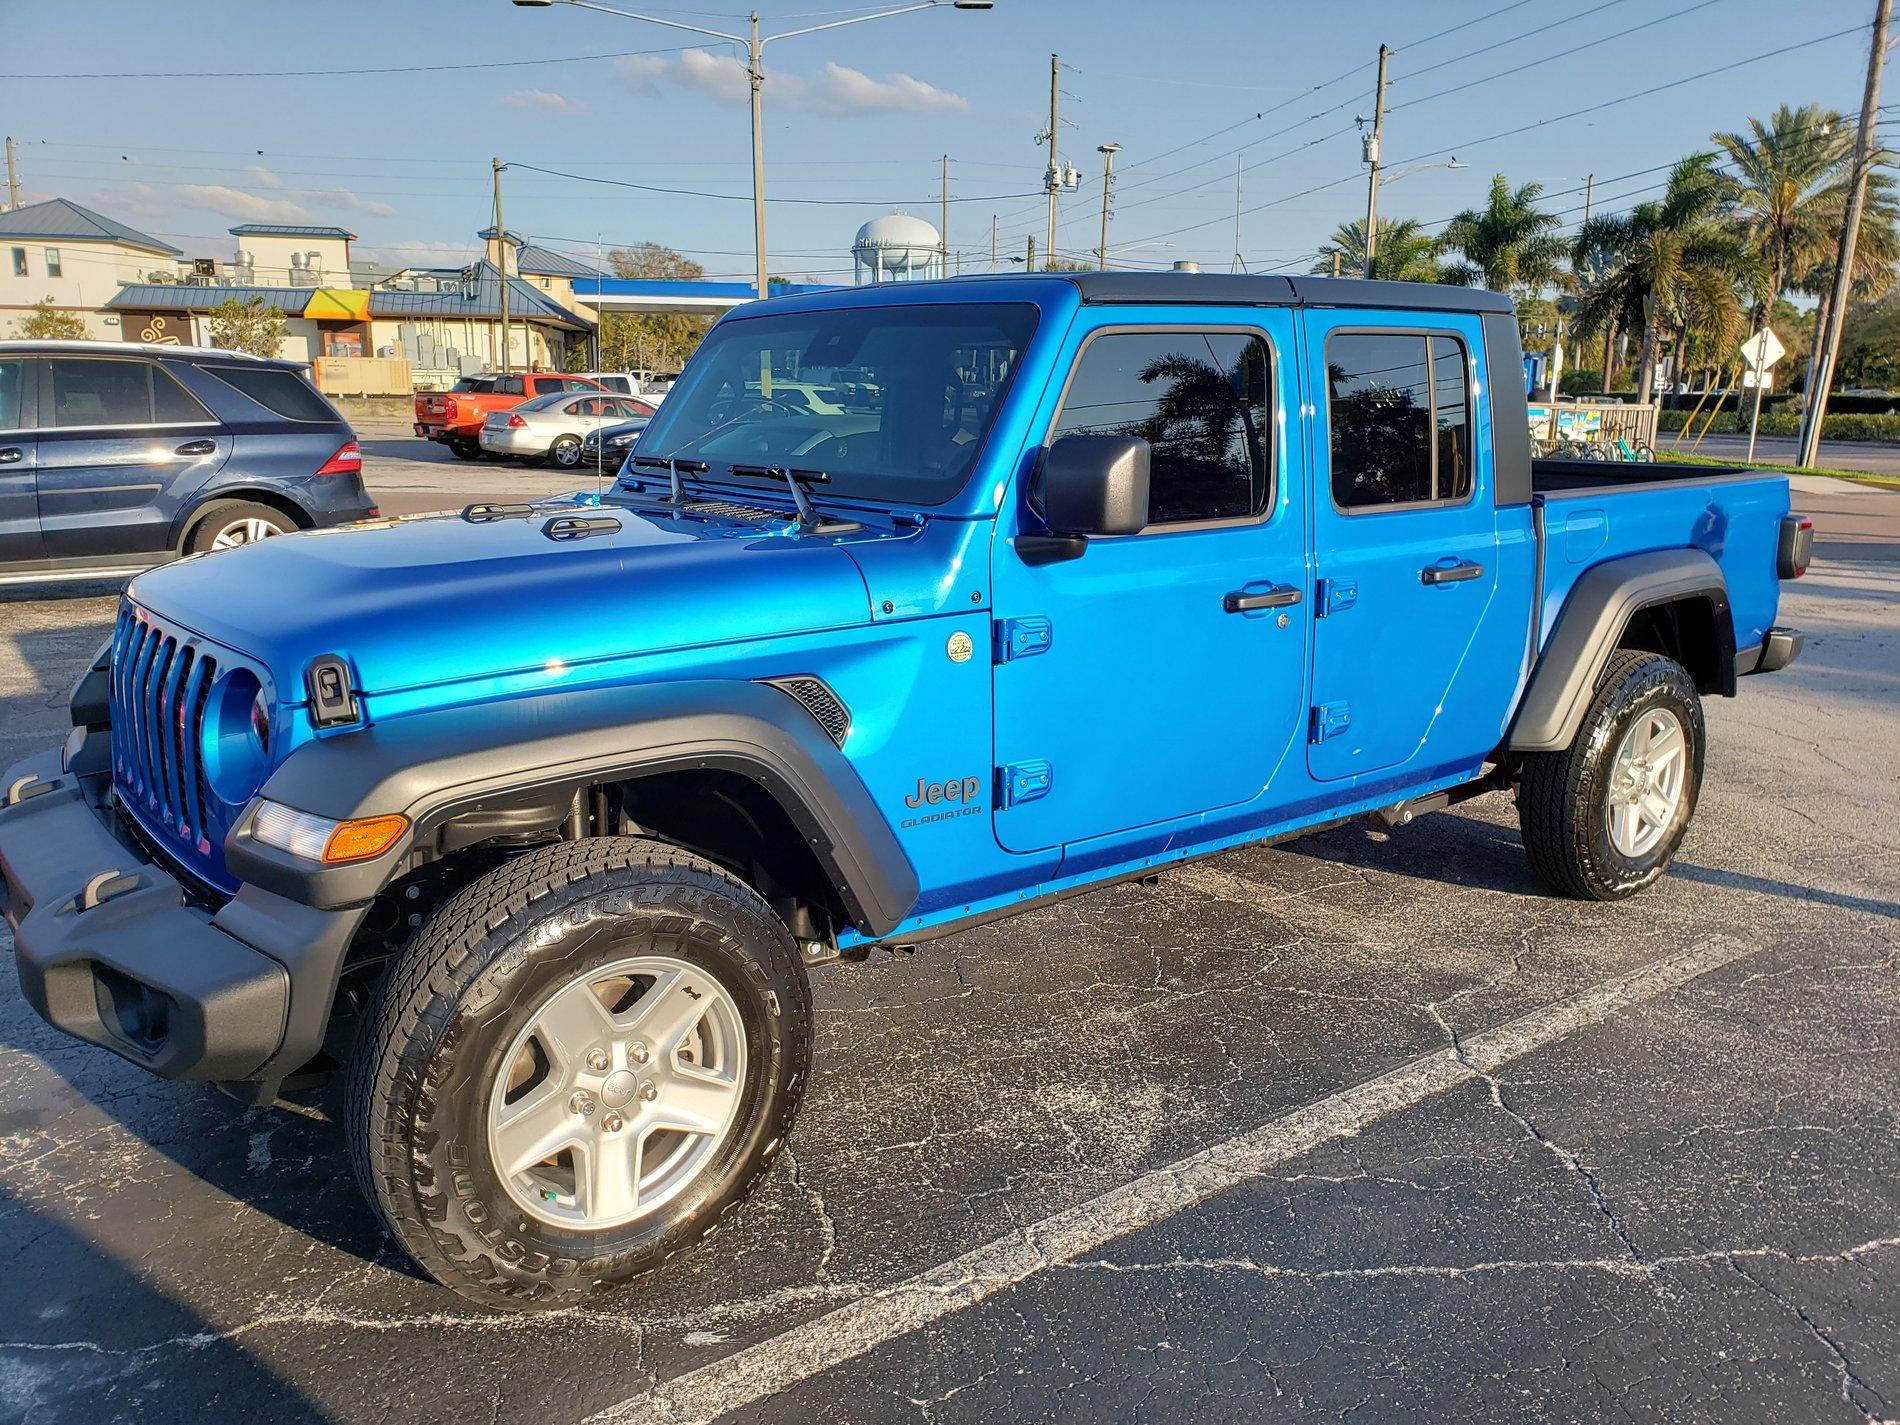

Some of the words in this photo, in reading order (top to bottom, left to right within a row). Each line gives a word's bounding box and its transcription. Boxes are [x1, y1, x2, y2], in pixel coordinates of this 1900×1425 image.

[905, 775, 980, 809] Jeep
[901, 806, 982, 829] GLADIATOR
[608, 915, 781, 1020] DUELER
